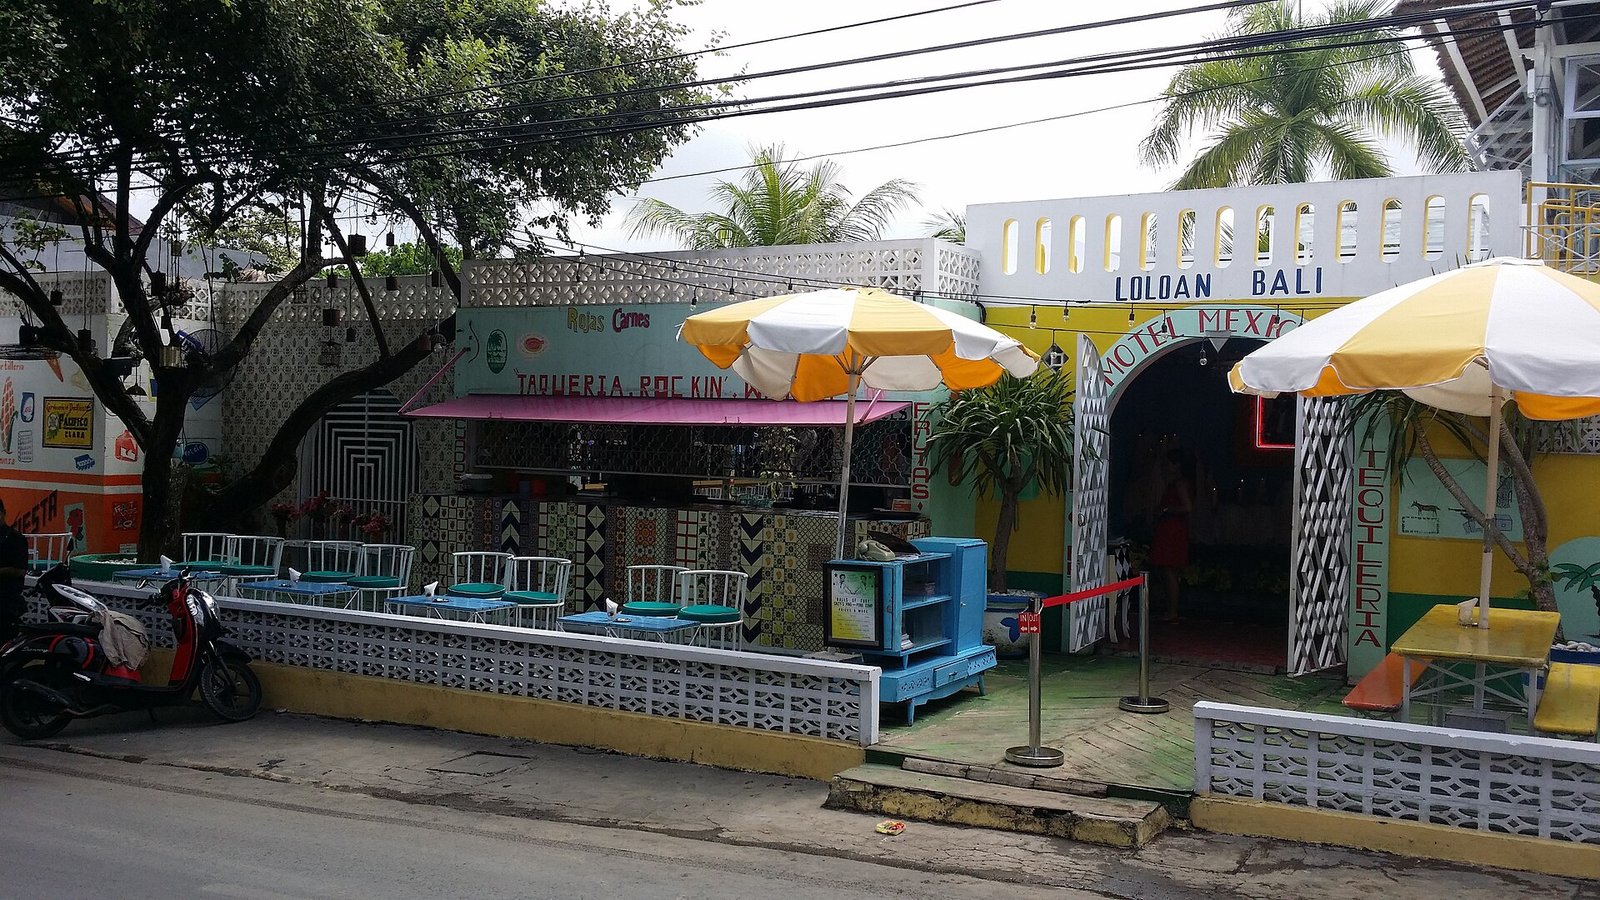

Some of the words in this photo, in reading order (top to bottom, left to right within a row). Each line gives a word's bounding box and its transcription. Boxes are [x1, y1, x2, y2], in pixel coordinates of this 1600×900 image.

[1115, 273, 1212, 301] LOLOAN
[1252, 267, 1322, 296] BALI
[567, 307, 605, 333] Rojas
[612, 308, 650, 333] Carnes
[1102, 315, 1184, 387] MOTEL
[1199, 309, 1297, 338] MEXIC
[912, 402, 931, 500] FRUTAS
[1354, 450, 1386, 648] TEQUILERIA
[1019, 614, 1027, 622] IN
[1029, 614, 1039, 622] OUT
